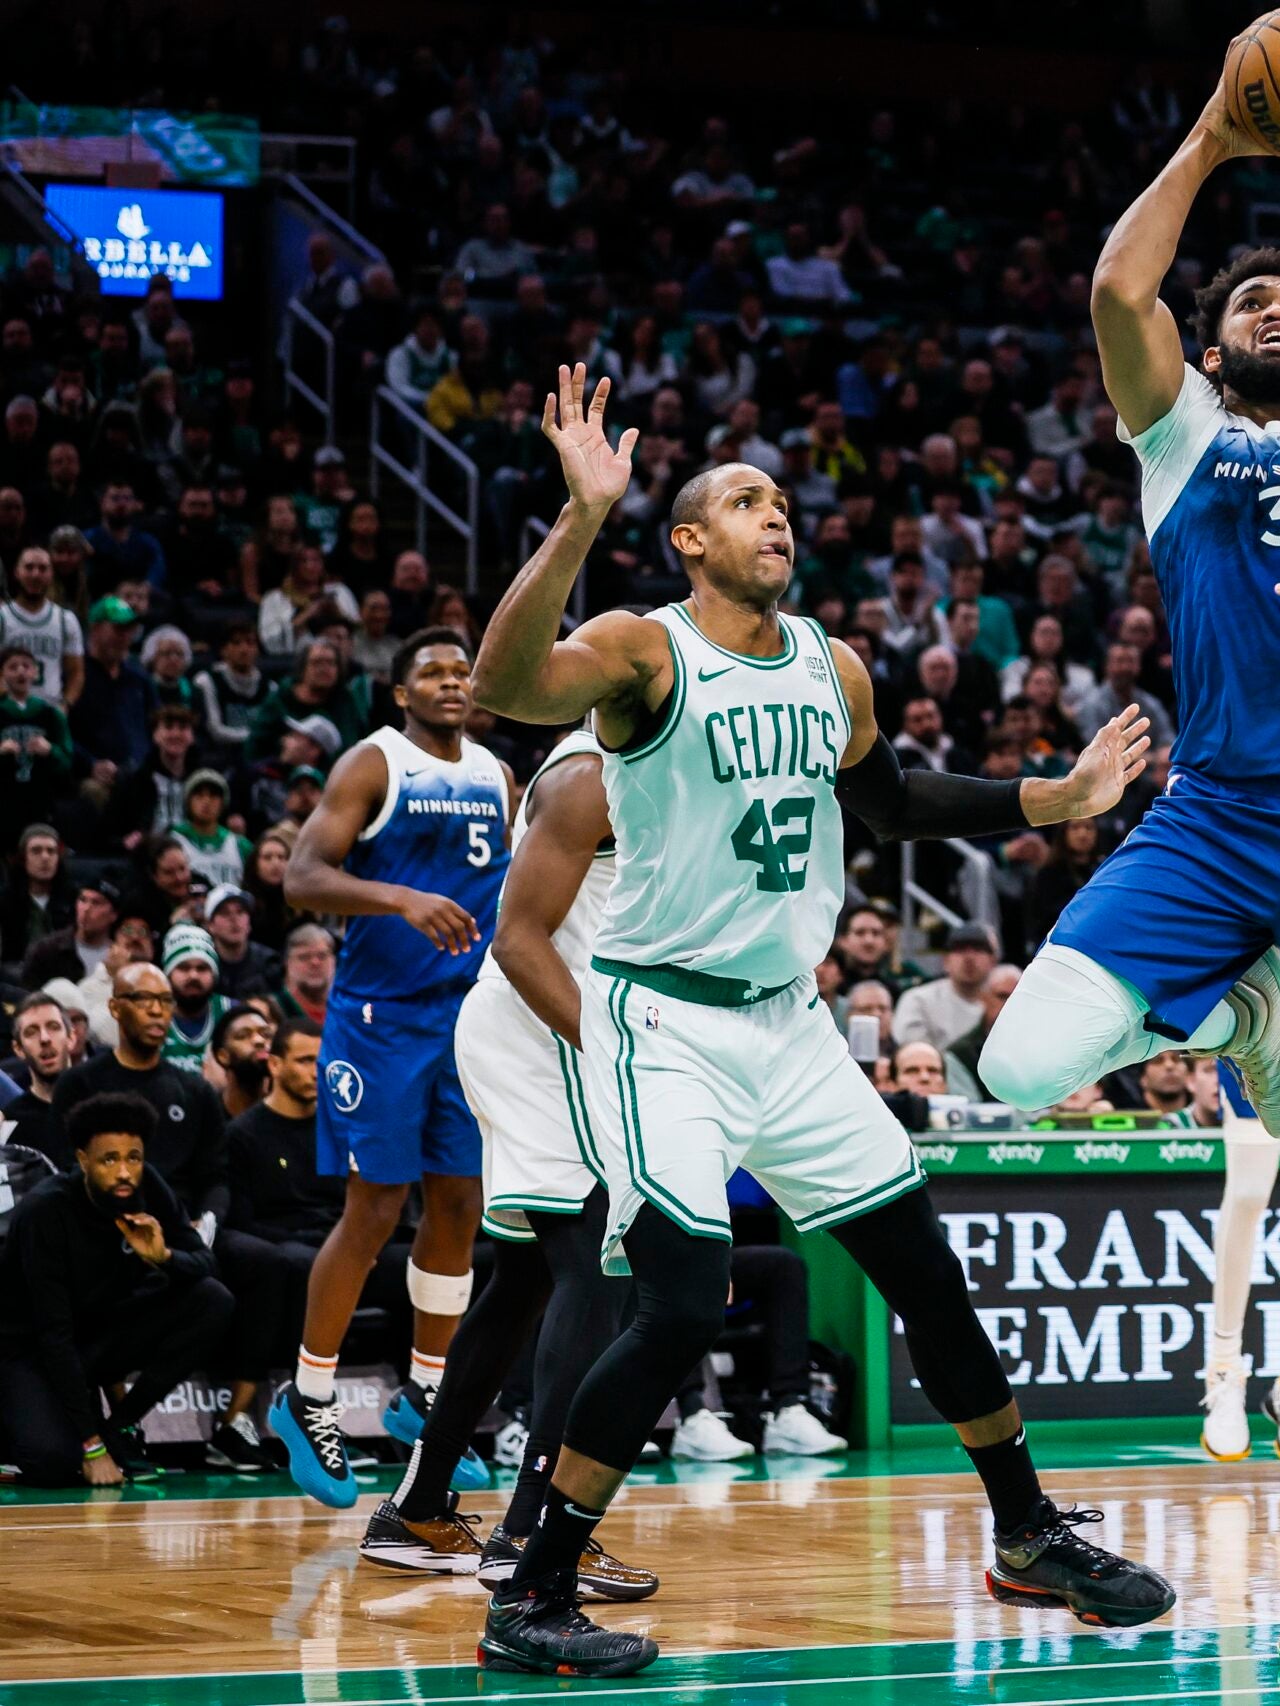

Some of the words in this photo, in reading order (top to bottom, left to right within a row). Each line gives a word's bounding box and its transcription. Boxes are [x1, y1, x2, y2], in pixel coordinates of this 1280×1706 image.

[84, 237, 212, 267] RBELLA
[705, 703, 838, 786] CELTICS
[407, 799, 498, 818] MINNESOTA
[466, 822, 492, 868] 5
[730, 796, 816, 893] 42
[986, 1141, 1045, 1165] xfinity
[1073, 1140, 1131, 1164] xfinity
[1159, 1140, 1215, 1163] xfinity
